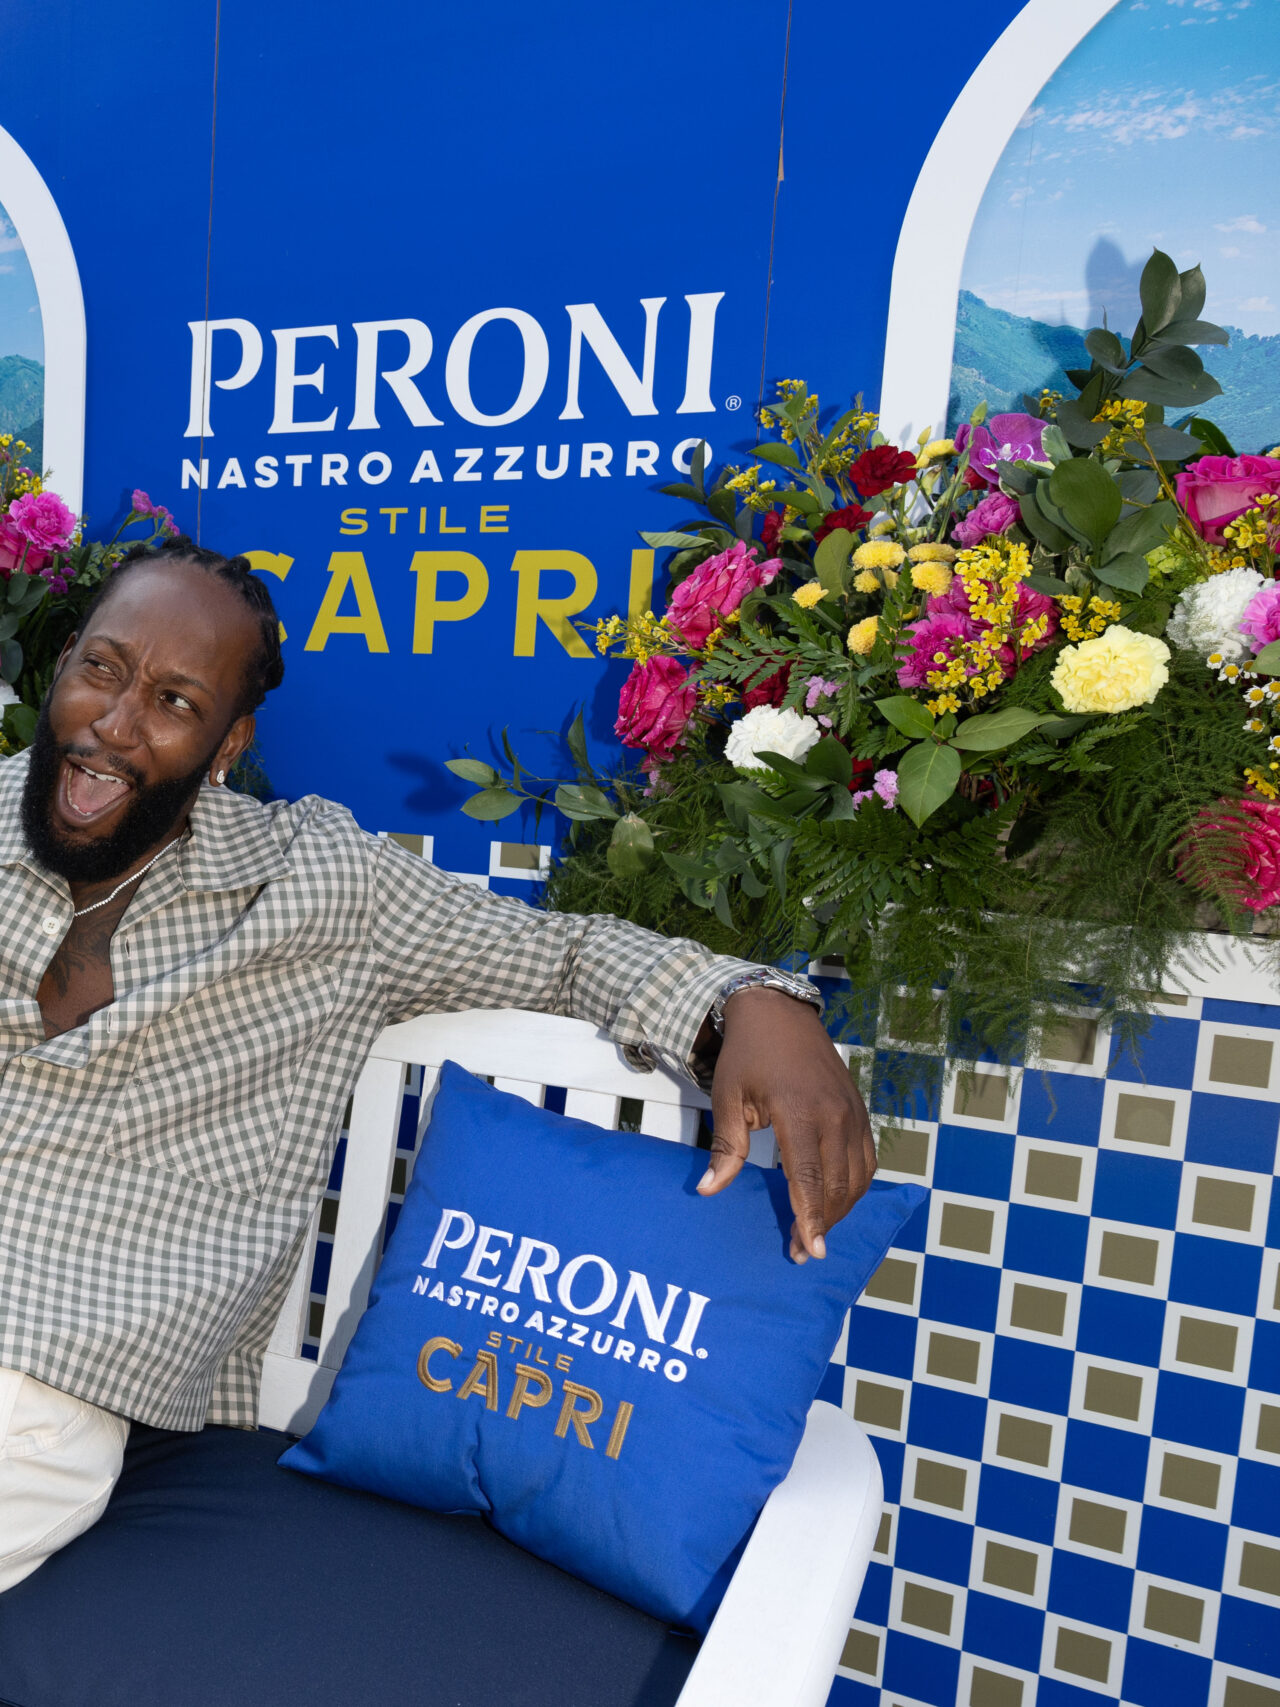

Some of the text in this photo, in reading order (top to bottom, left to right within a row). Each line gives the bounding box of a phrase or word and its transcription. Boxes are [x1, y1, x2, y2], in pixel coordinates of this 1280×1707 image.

[183, 291, 726, 438] PERONI
[181, 438, 713, 490] NASTRO AZZURRO
[339, 505, 510, 535] STILE
[411, 1275, 688, 1383] NASTRO AZZURRO
[421, 1208, 711, 1356] PERONI
[417, 1336, 634, 1460] CAPRI
[486, 1331, 574, 1373] STILE
